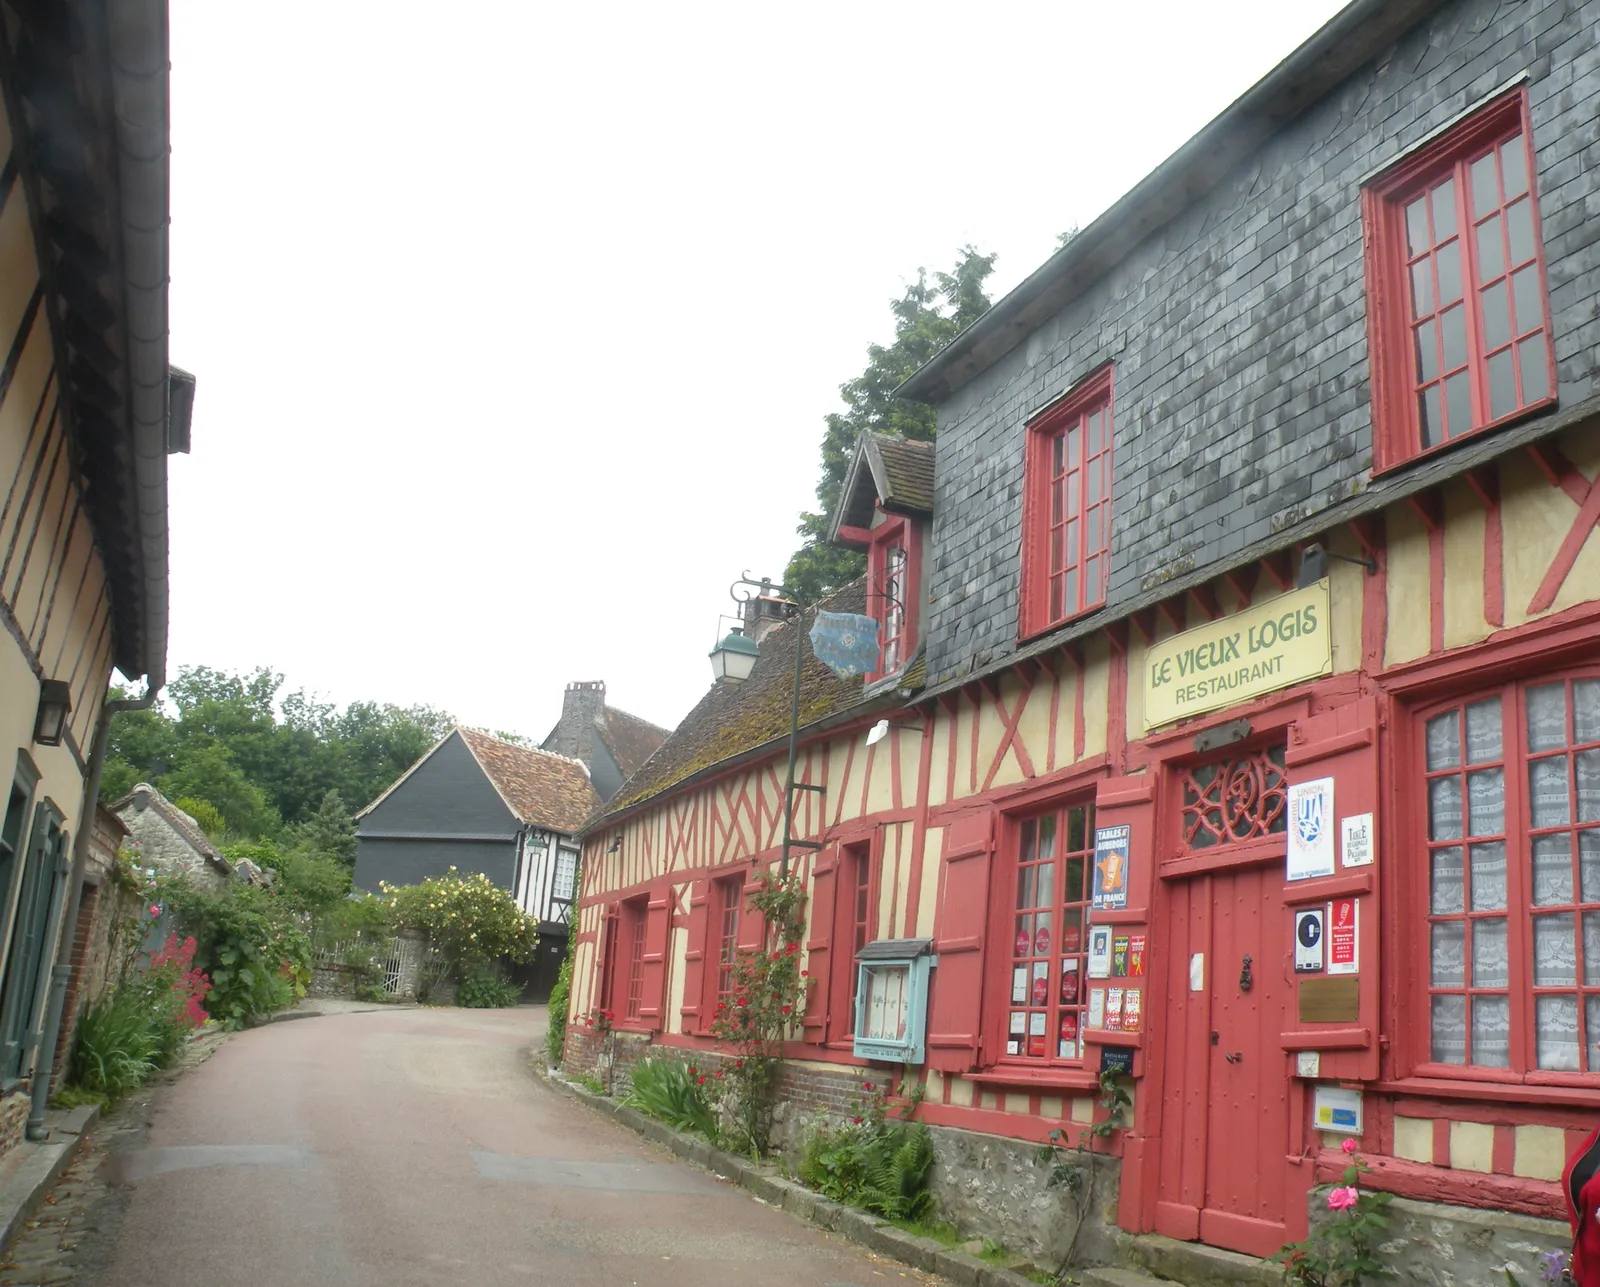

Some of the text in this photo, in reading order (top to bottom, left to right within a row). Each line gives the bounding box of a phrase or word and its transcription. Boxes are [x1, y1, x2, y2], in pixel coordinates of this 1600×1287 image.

[1152, 605, 1318, 688] LE VIEUX LOGIS
[1176, 654, 1284, 705] RESTAURANT
[1297, 784, 1324, 797] UNION
[1098, 829, 1122, 840] TABLES
[1098, 838, 1127, 851] AUBERGES
[1095, 893, 1125, 903] DE FRANCE
[1127, 996, 1138, 1004] 2012
